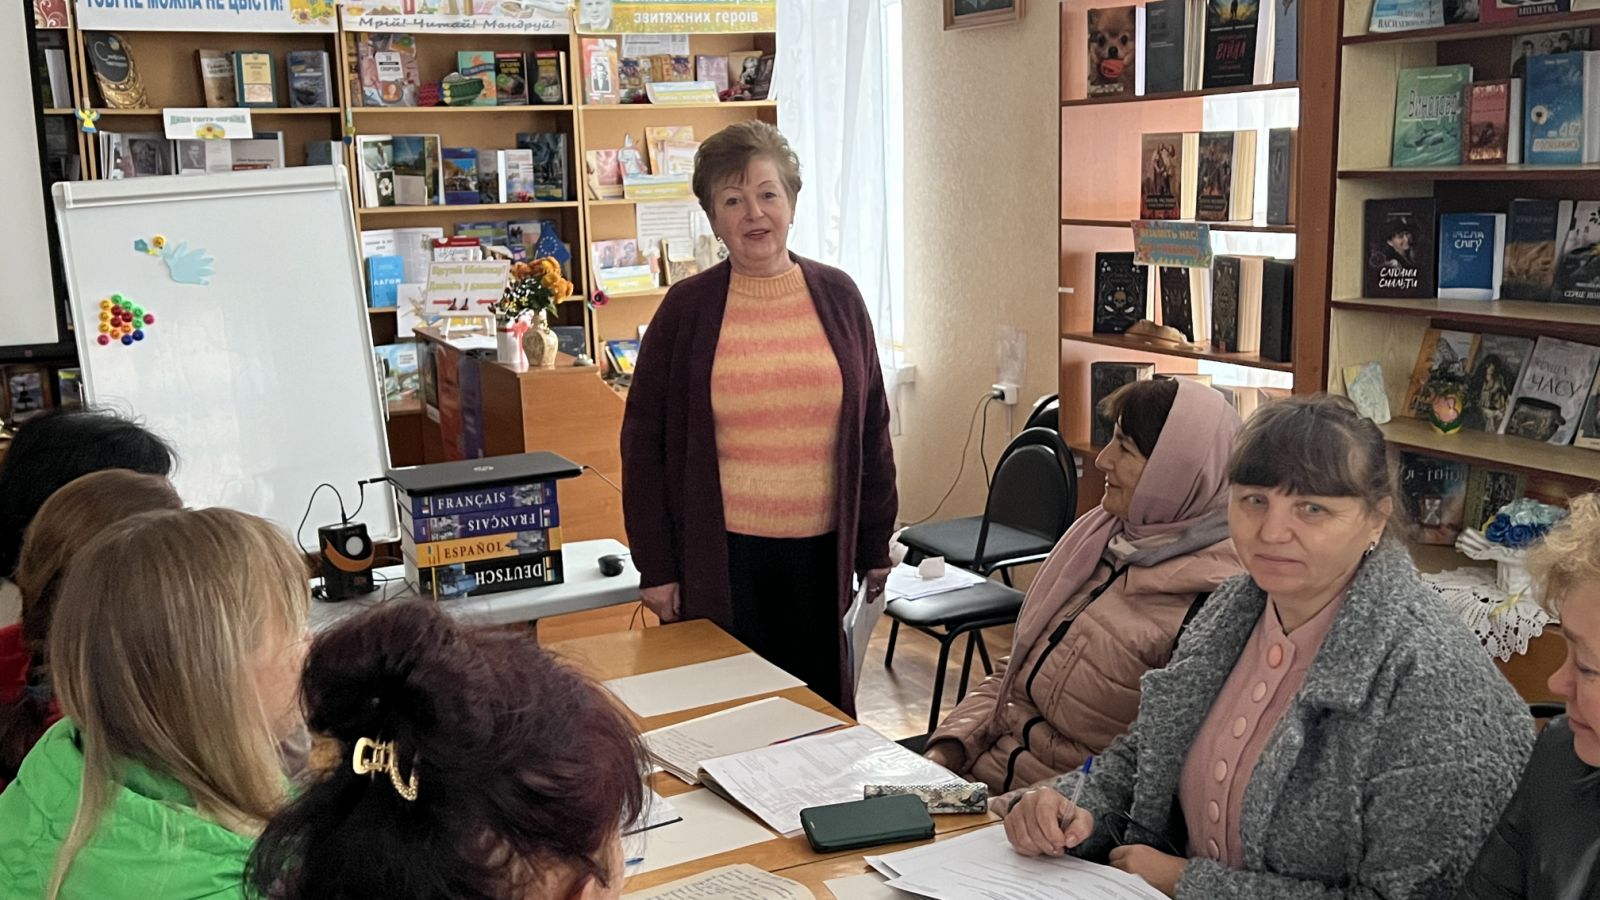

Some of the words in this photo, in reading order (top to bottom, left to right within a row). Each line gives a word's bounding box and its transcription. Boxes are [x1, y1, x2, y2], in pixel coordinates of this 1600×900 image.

[123, 0, 143, 9] НЕ
[147, 0, 203, 10] МОЖНА
[207, 0, 225, 10] НЕ
[359, 16, 406, 30] Мрій!
[413, 17, 476, 29] Читай!
[483, 19, 556, 31] Мандруй!
[633, 11, 711, 24] звитяжних
[715, 11, 759, 26] героїв
[1531, 373, 1584, 399] ЧАСУ
[437, 491, 507, 511] FRANÇAIS
[467, 512, 537, 532] FRANÇAIS
[444, 541, 504, 560] ESPAÑOL
[475, 565, 543, 585] DEUTSCH
